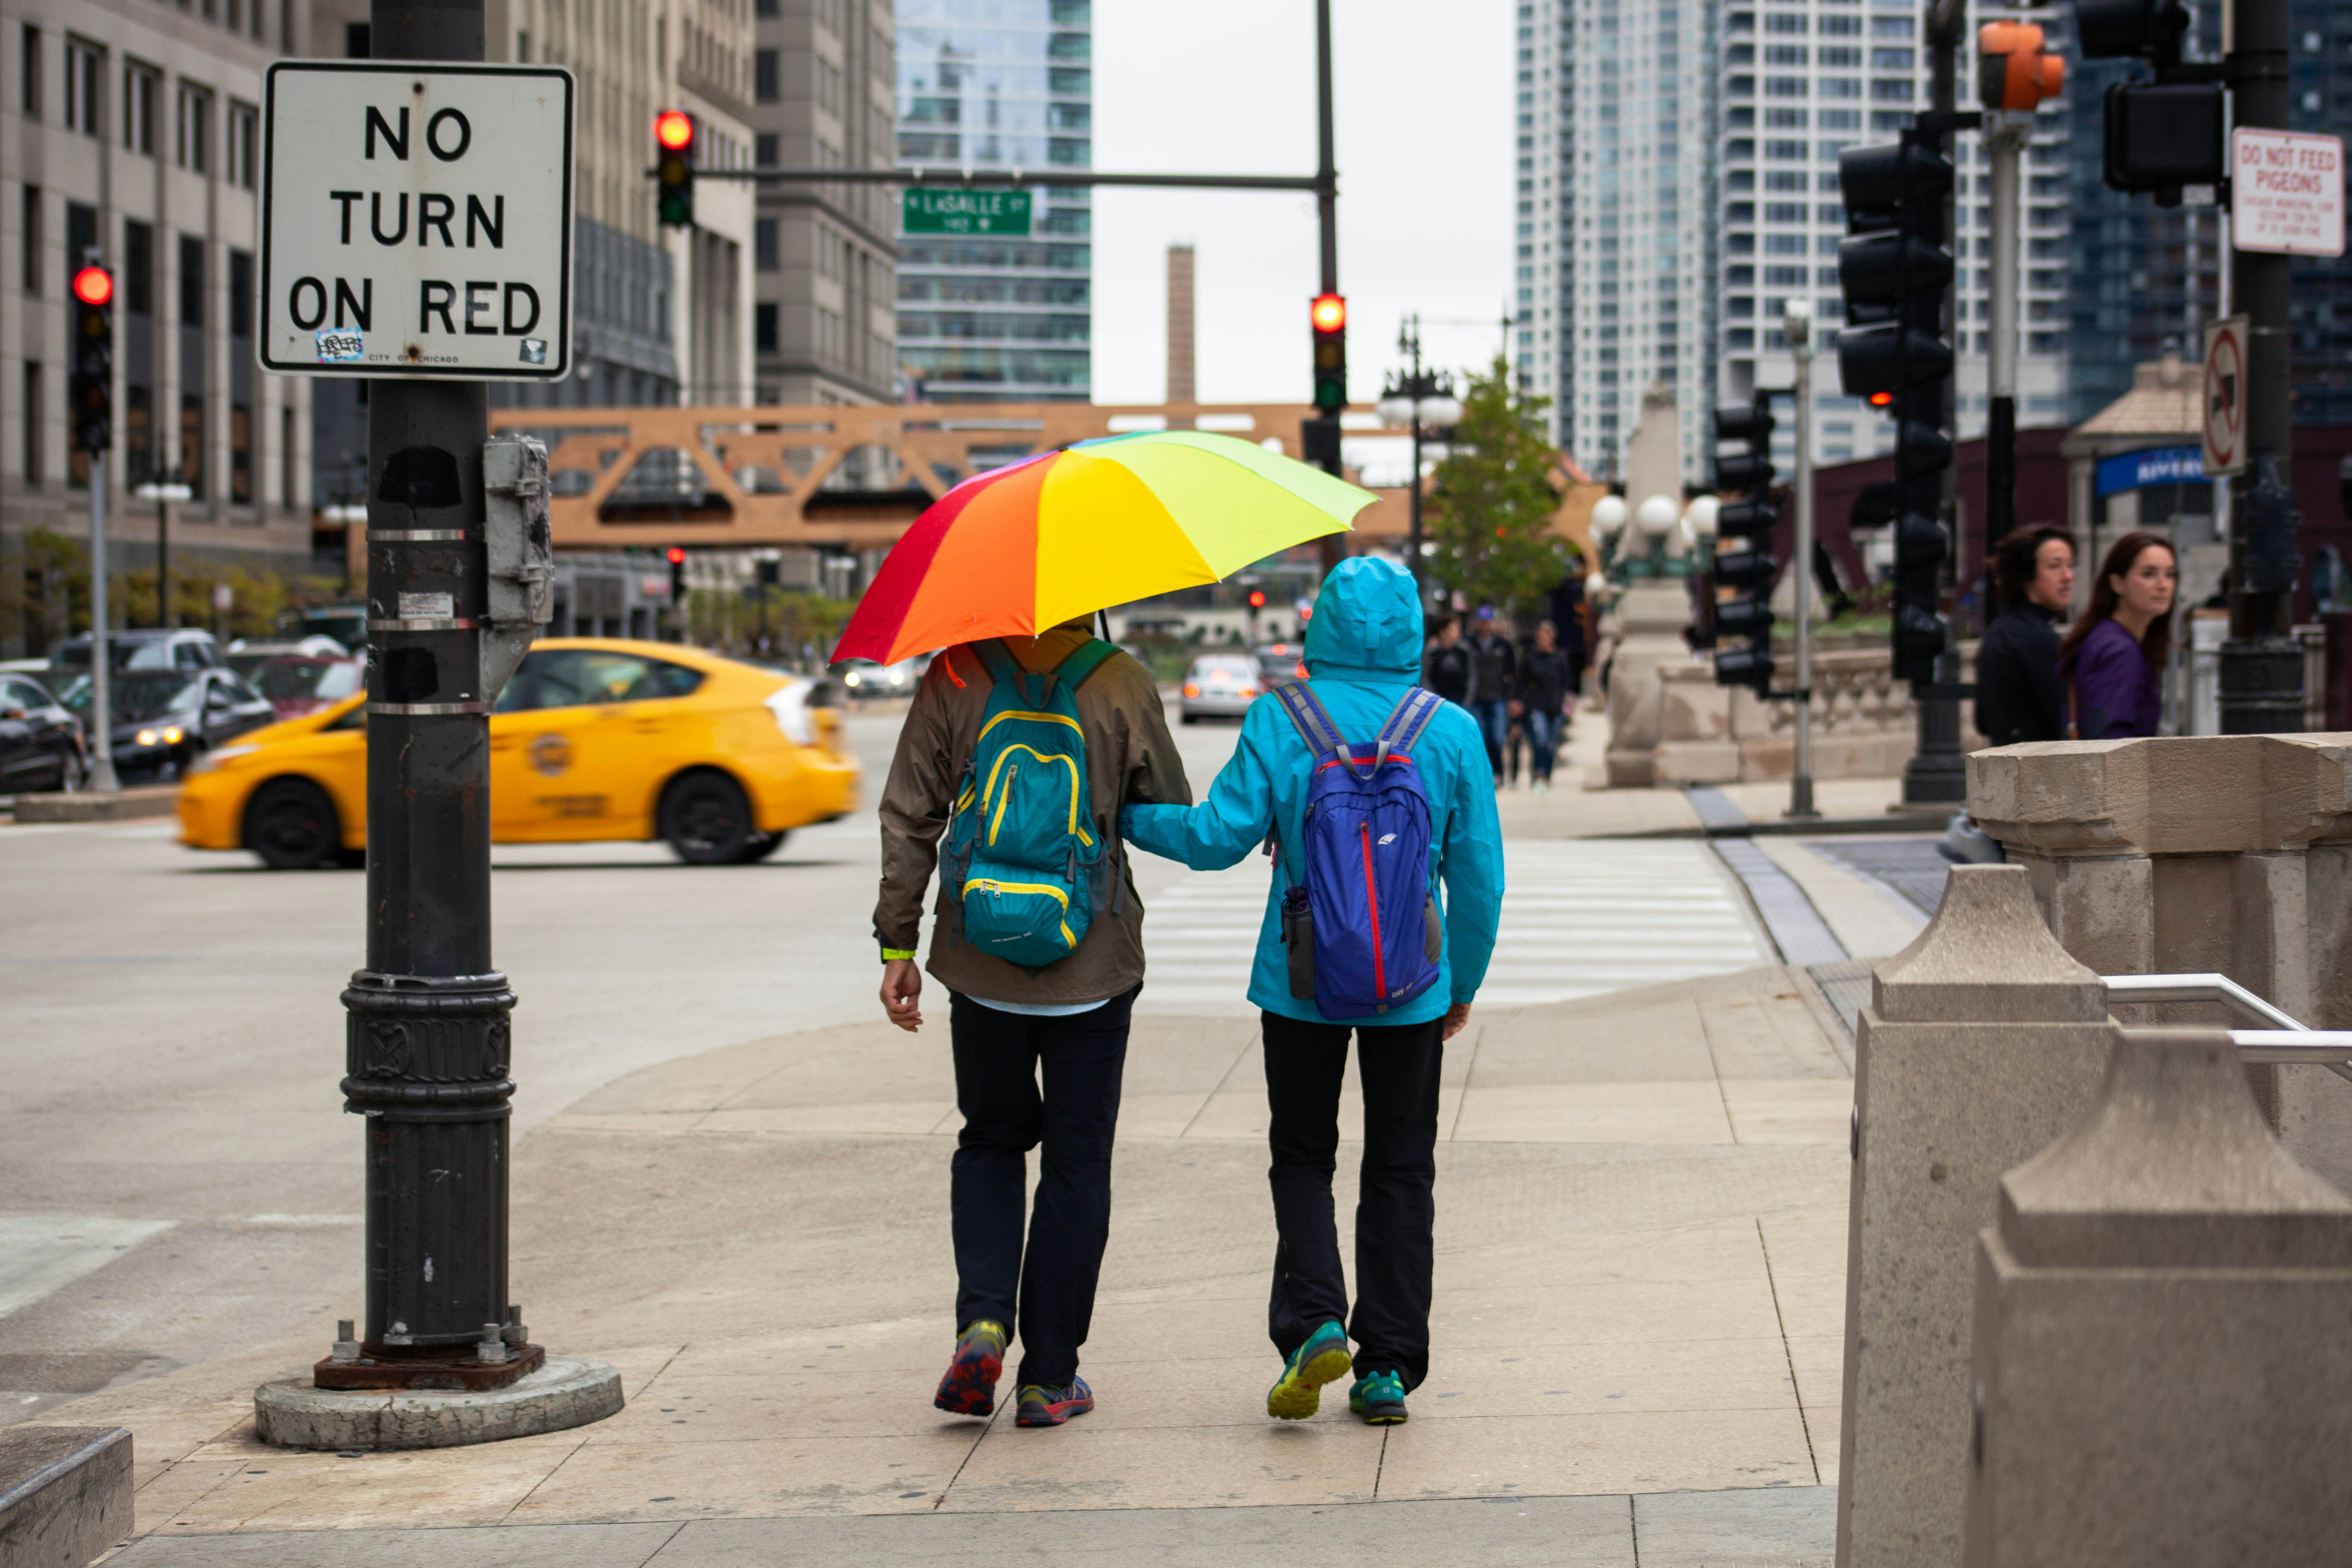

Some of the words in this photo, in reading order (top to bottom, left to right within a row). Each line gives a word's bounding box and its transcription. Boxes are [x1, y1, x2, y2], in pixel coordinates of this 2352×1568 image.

[365, 106, 471, 162] NO
[2242, 144, 2260, 165] DO
[2267, 147, 2294, 168] NOT
[2299, 149, 2335, 171] FEED
[2256, 170, 2322, 194] PIGEONS
[330, 191, 504, 248] TURN
[289, 276, 372, 332] ON
[420, 280, 540, 336] RED
[1392, 988, 1404, 998] DAY
